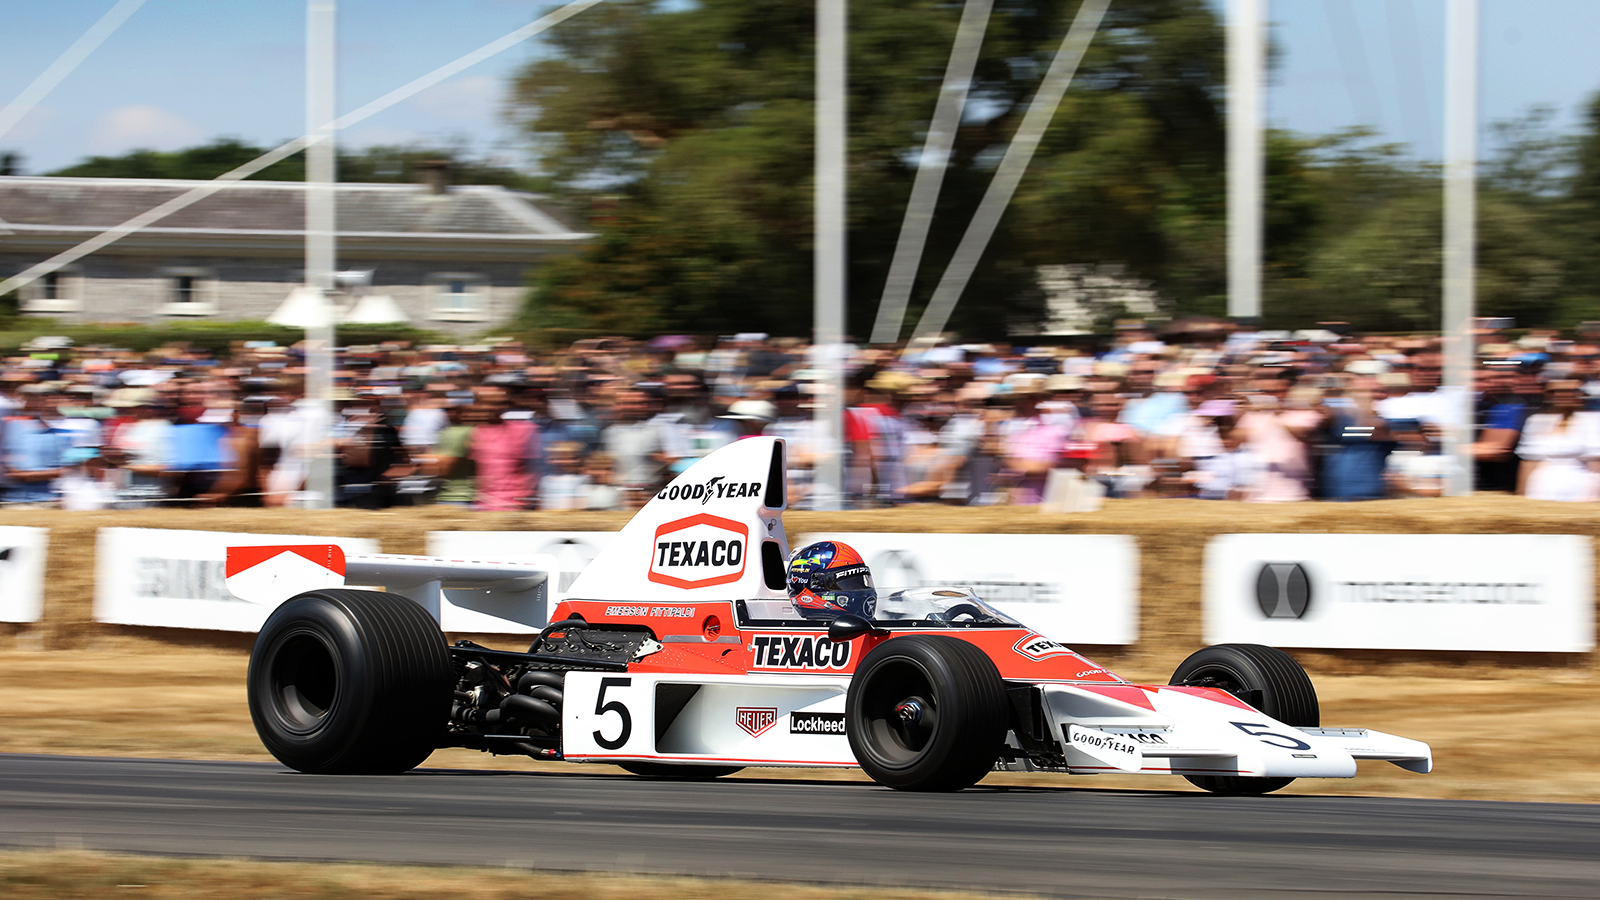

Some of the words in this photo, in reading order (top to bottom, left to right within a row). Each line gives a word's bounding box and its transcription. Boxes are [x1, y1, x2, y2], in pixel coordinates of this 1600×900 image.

[658, 540, 742, 567] TEXACO
[604, 605, 649, 617] EMERSON
[649, 606, 696, 618] FITTIPALDI
[754, 636, 850, 667] TEXACO
[592, 676, 632, 750] 5
[739, 711, 773, 732] HEUER
[790, 716, 846, 733] Lockheed
[1228, 721, 1312, 751] 5
